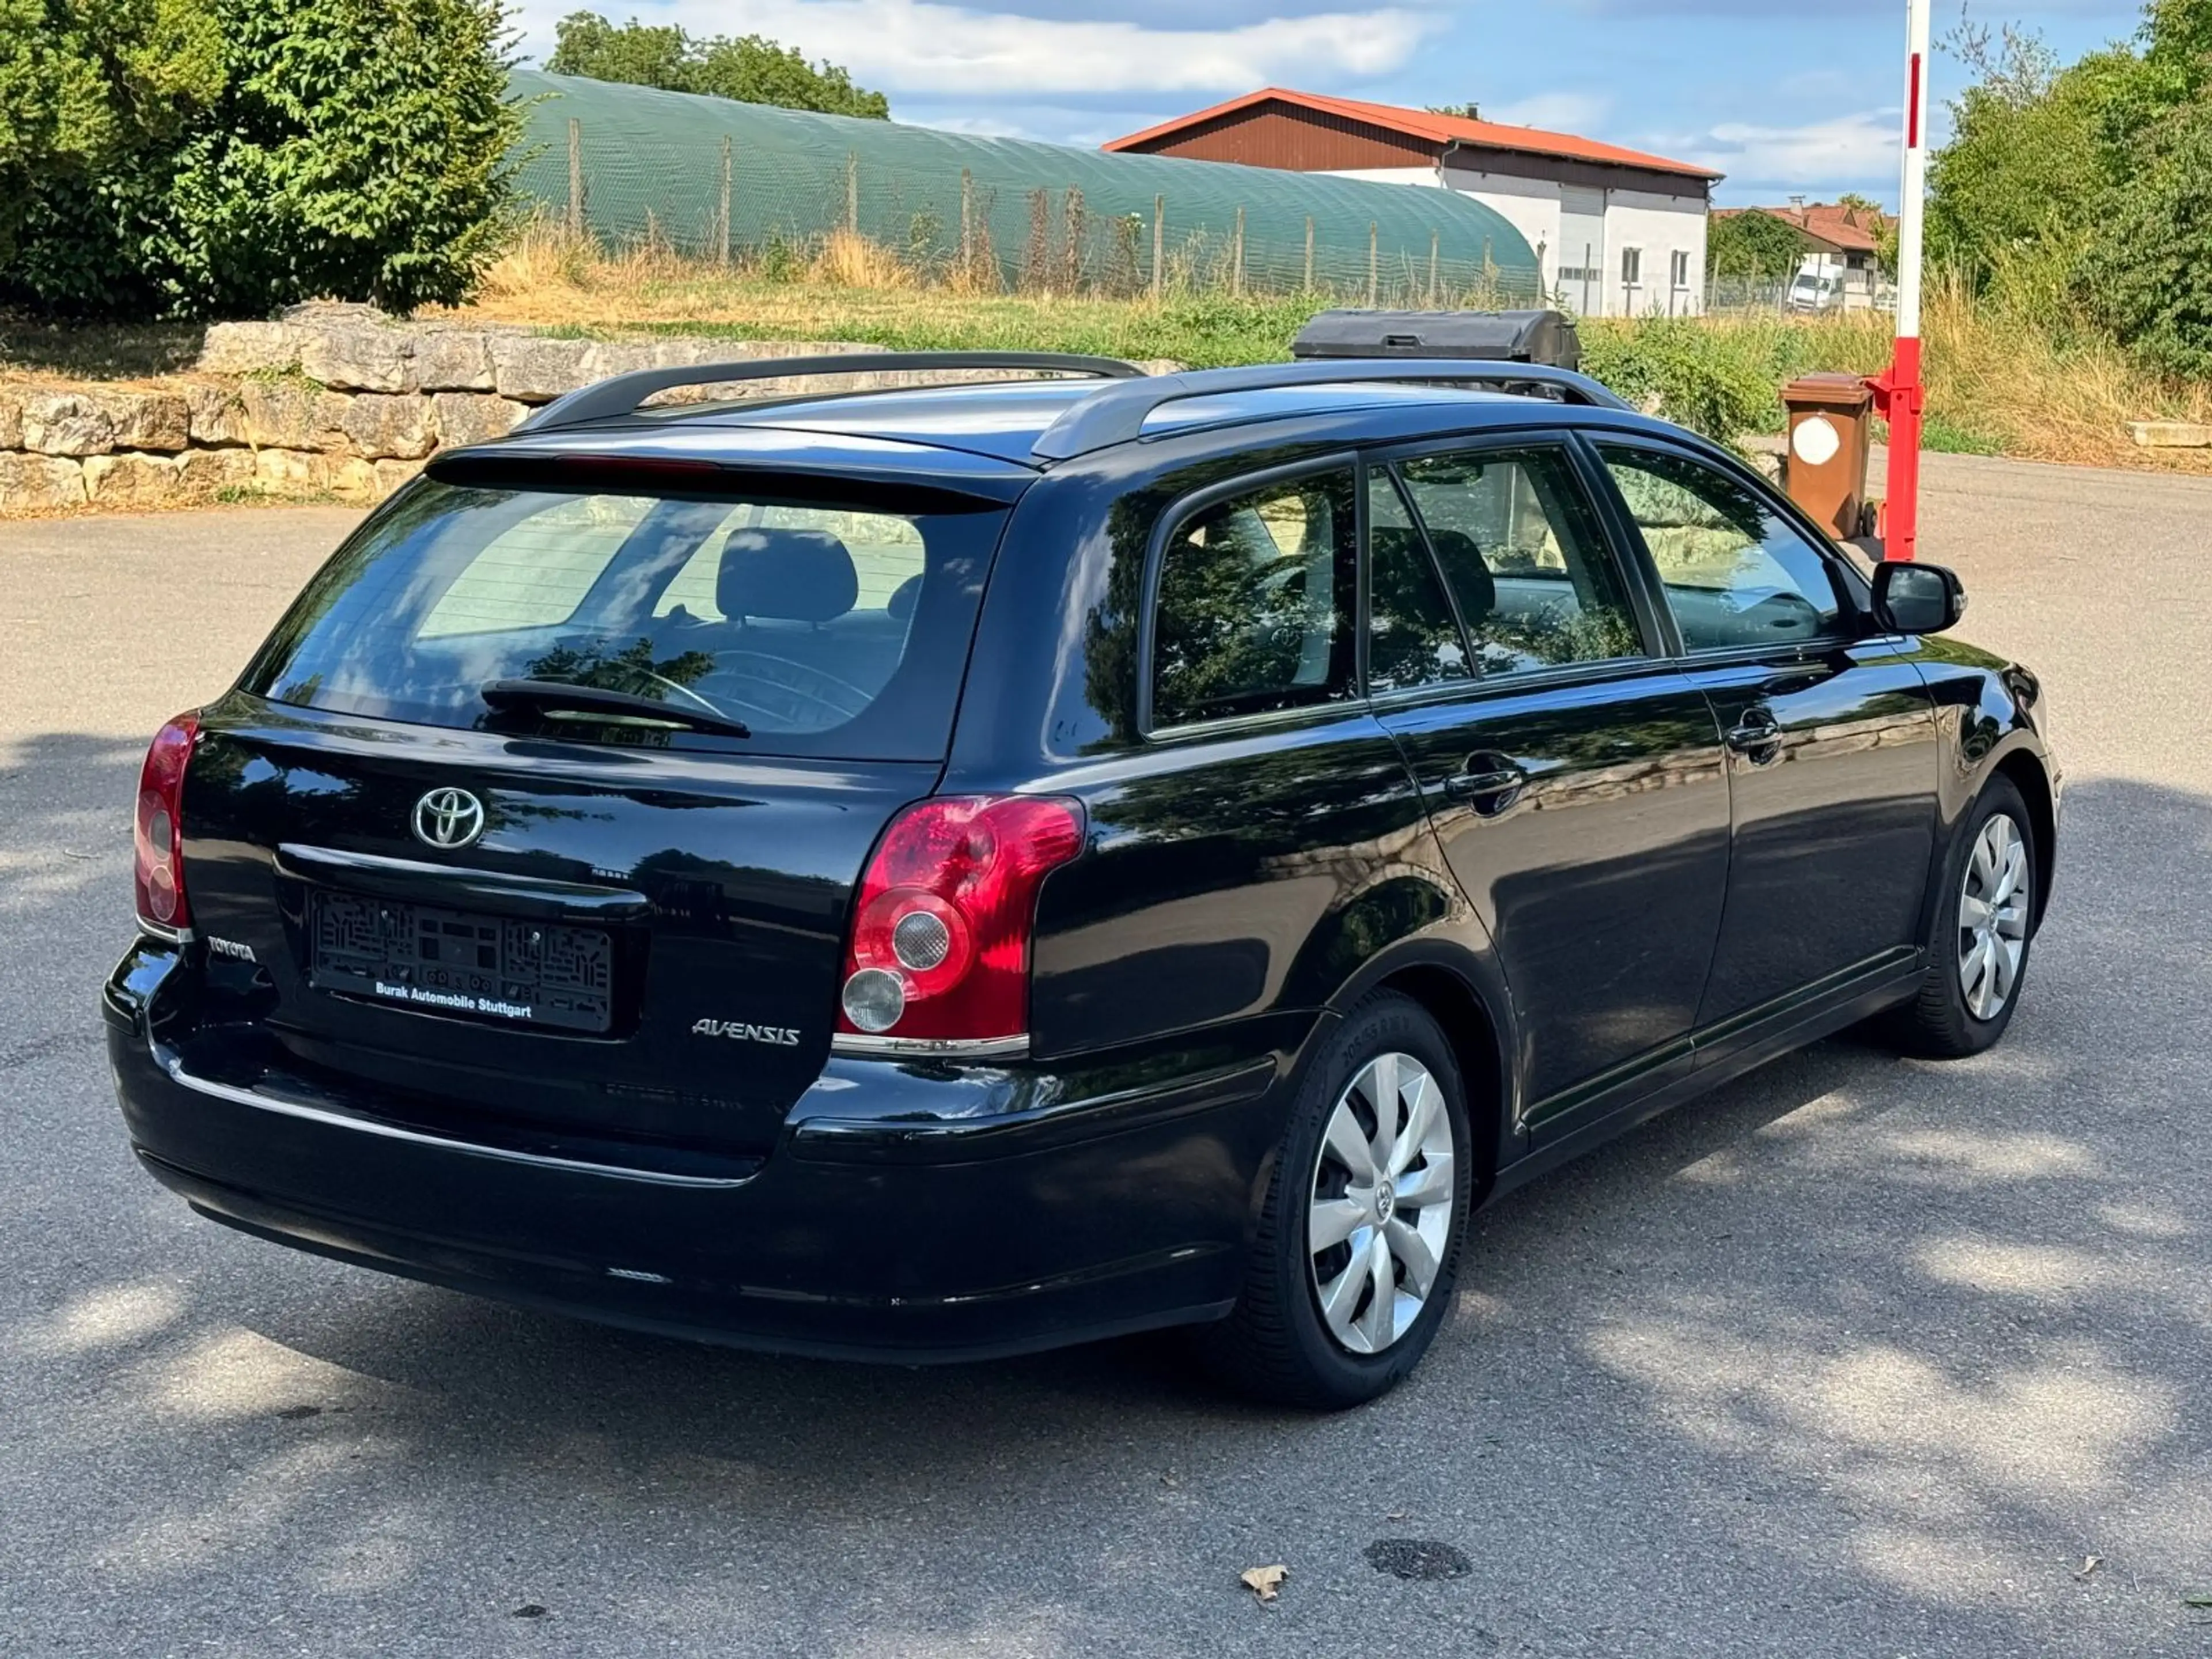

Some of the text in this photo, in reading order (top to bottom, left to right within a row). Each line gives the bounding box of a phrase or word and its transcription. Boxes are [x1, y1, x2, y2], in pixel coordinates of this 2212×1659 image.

[208, 935, 257, 963] TOYOTA
[376, 981, 531, 1018] Burak Automobile Stuttgart
[692, 1018, 801, 1046] AVENSIS
